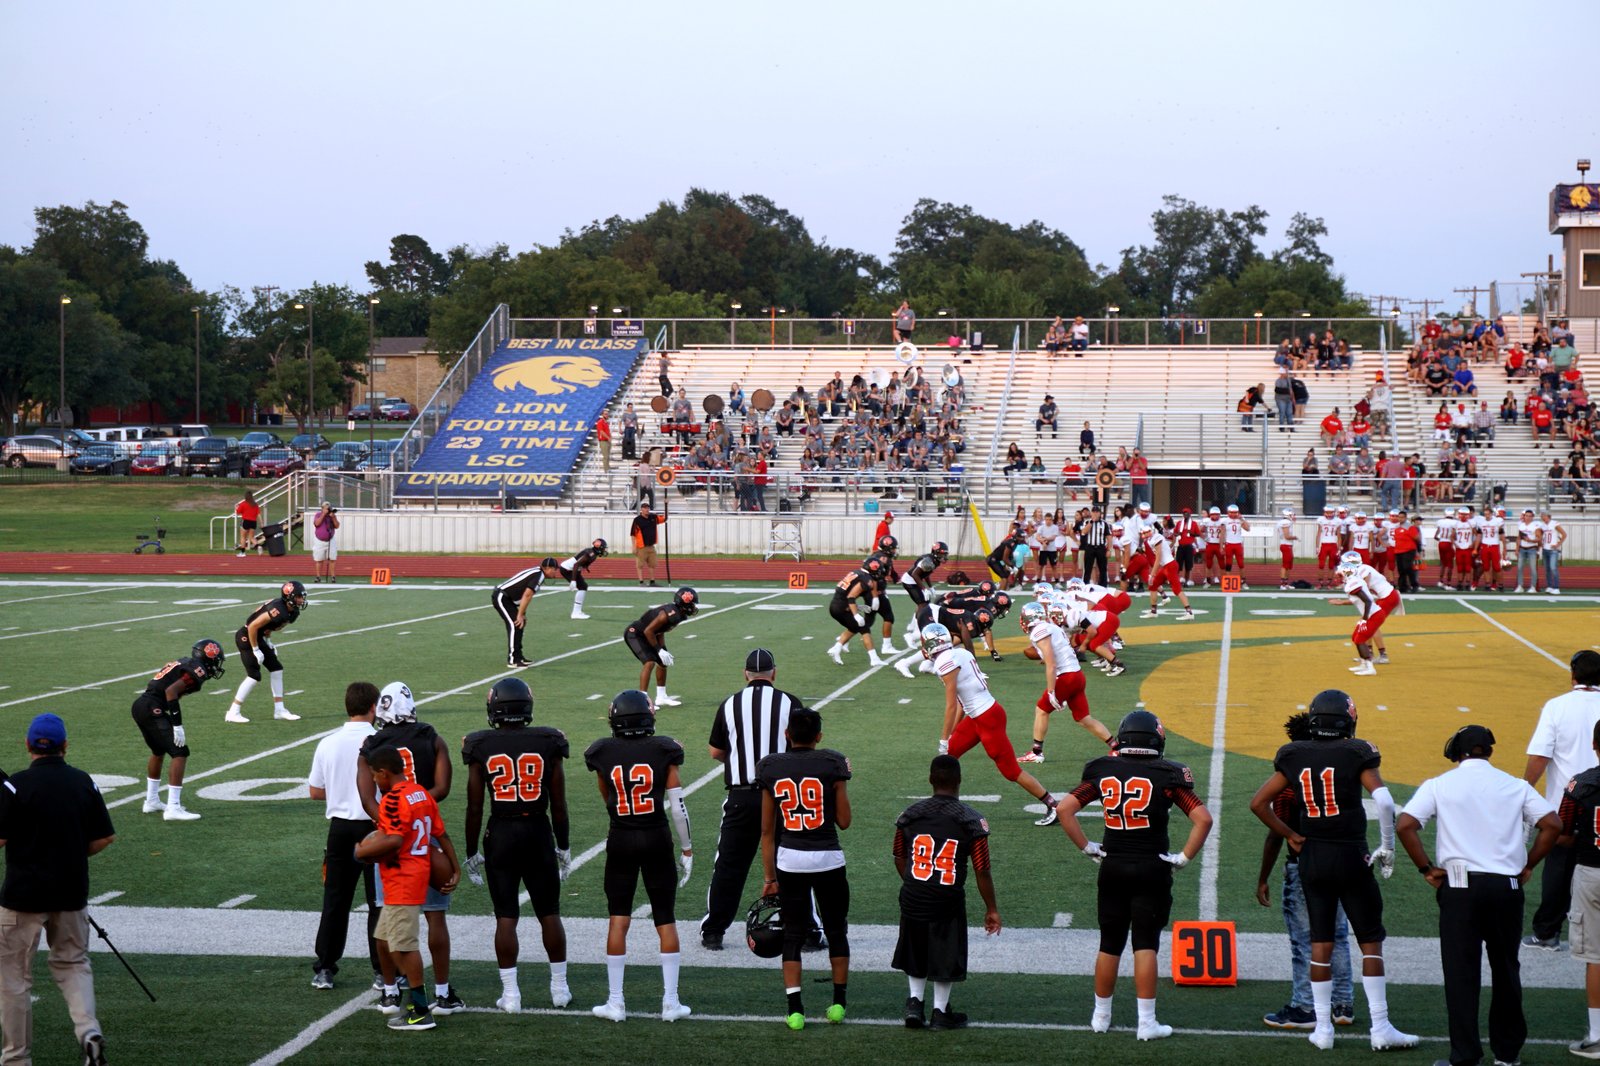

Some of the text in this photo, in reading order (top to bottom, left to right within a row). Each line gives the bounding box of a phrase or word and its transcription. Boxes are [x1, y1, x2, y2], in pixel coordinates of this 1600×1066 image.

[507, 339, 638, 350] BEST IN CLASS
[495, 402, 567, 414] LION
[446, 419, 588, 432] FOOTBALL
[445, 436, 574, 449] 23 TIME
[466, 454, 528, 467] LSC
[374, 570, 386, 583] 10
[791, 573, 805, 587] 20
[1223, 577, 1239, 591] 30
[486, 752, 545, 802] 28
[610, 763, 655, 816] 12
[774, 777, 825, 832] 29
[1099, 776, 1154, 831] 22
[1299, 767, 1340, 818] 11
[410, 815, 432, 857] 21
[911, 833, 959, 886] 84
[1179, 927, 1232, 979] 30
